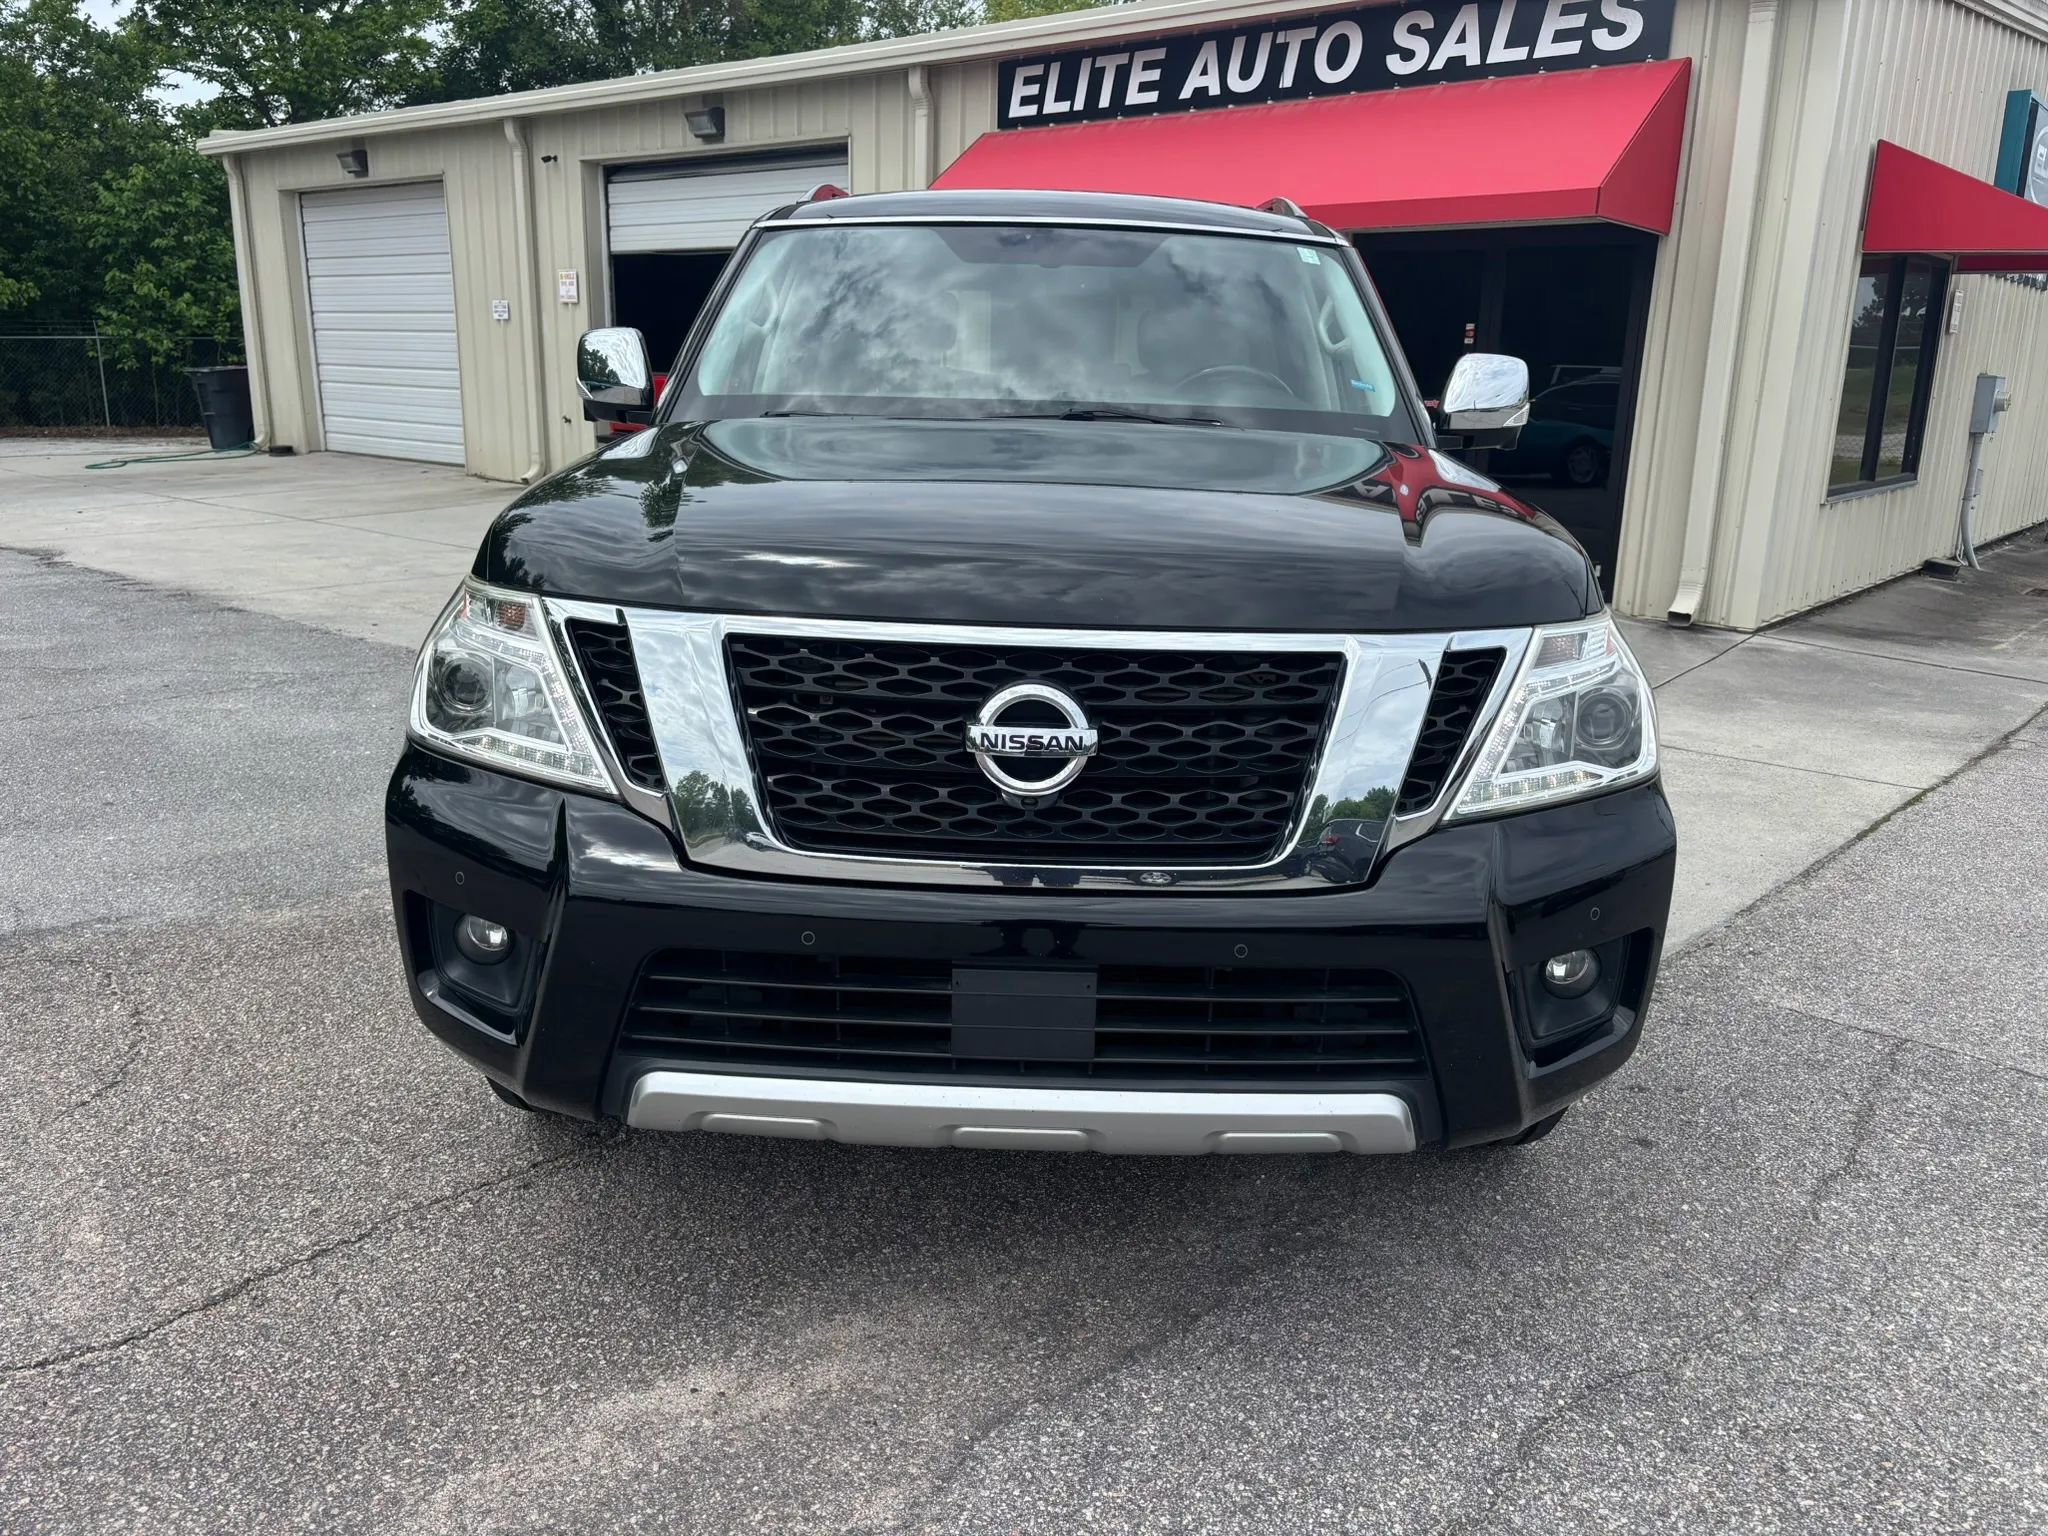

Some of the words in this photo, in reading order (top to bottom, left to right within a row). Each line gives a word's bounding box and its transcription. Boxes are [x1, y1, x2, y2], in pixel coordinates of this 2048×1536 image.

[1008, 47, 1167, 119] ELITE
[1178, 20, 1364, 100] AUTO
[1385, 0, 1644, 75] SALES
[980, 732, 1084, 751] NISSAN
